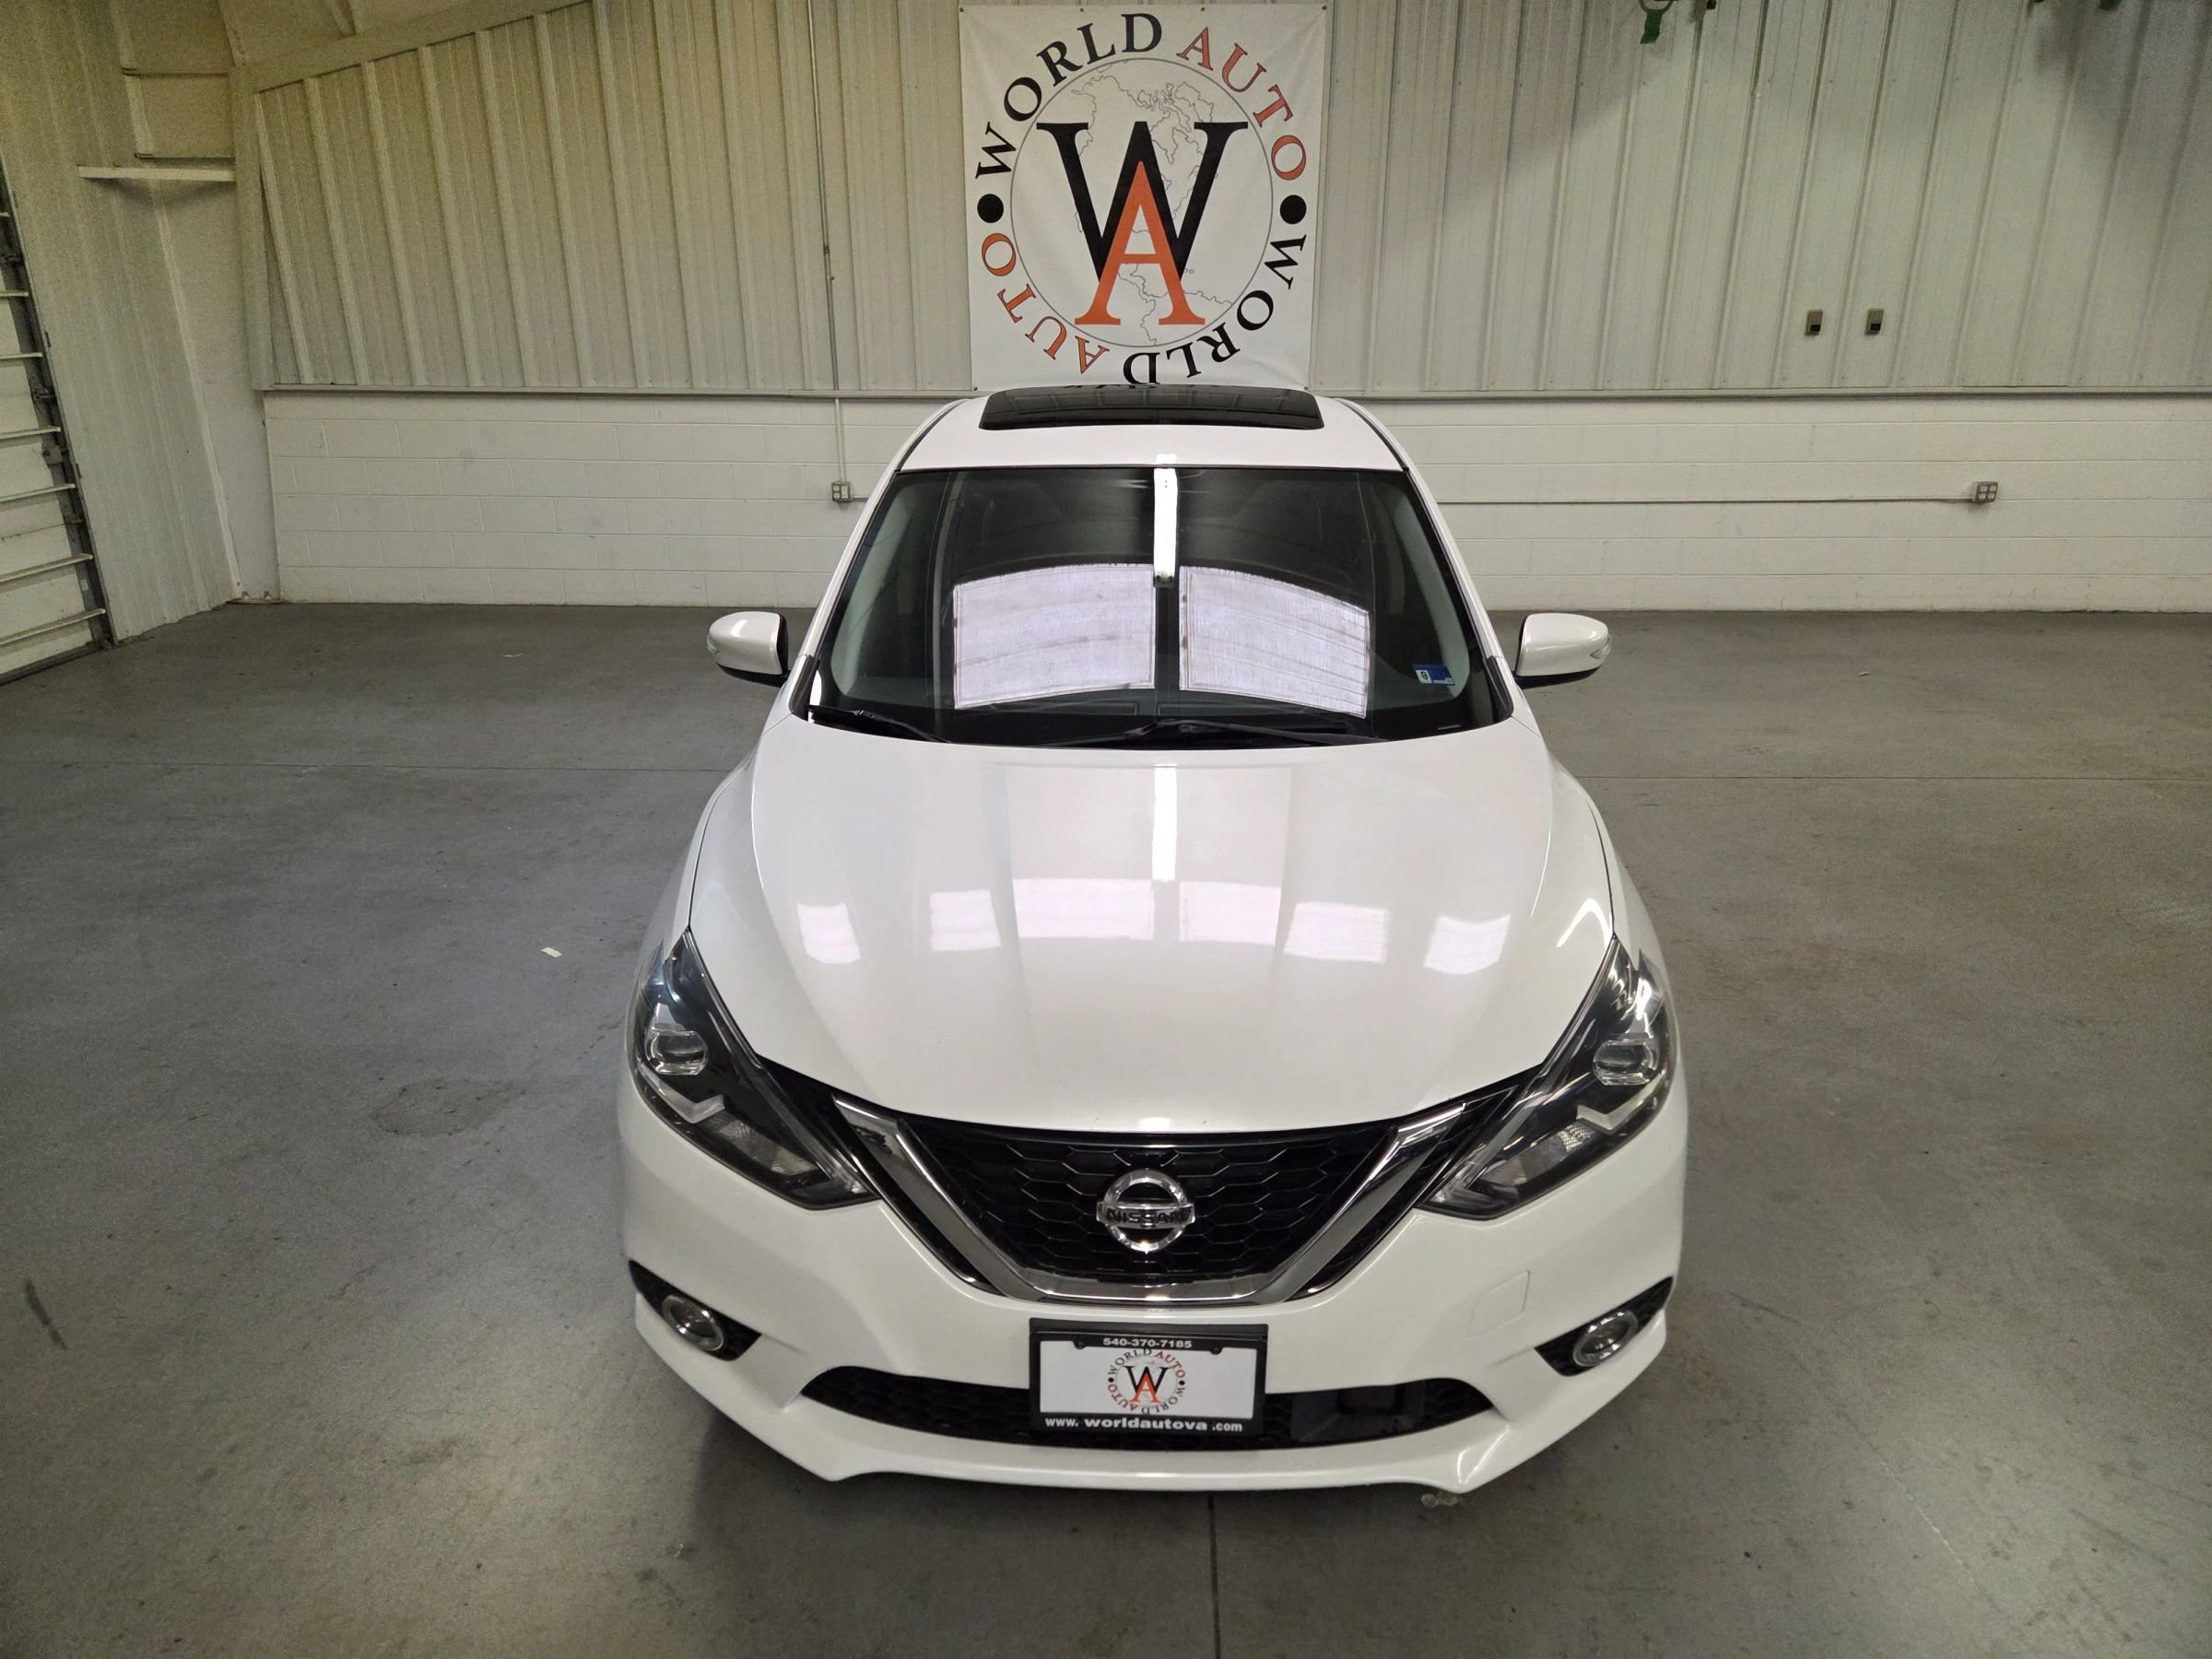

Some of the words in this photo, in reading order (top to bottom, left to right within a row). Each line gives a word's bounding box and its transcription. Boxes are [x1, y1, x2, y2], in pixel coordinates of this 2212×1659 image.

[975, 13, 1162, 180] WORLD
[1177, 27, 1307, 181] AUTO
[982, 232, 1110, 374] AUTO
[1123, 234, 1307, 385] WORLD
[1106, 1207, 1185, 1225] NISSAN
[1103, 1338, 1193, 1348] 540-370-7185
[1107, 1348, 1152, 1375] WORLD
[1154, 1350, 1186, 1379] AUTO
[1108, 1383, 1139, 1412] AUTO
[1141, 1387, 1186, 1415] WORLD
